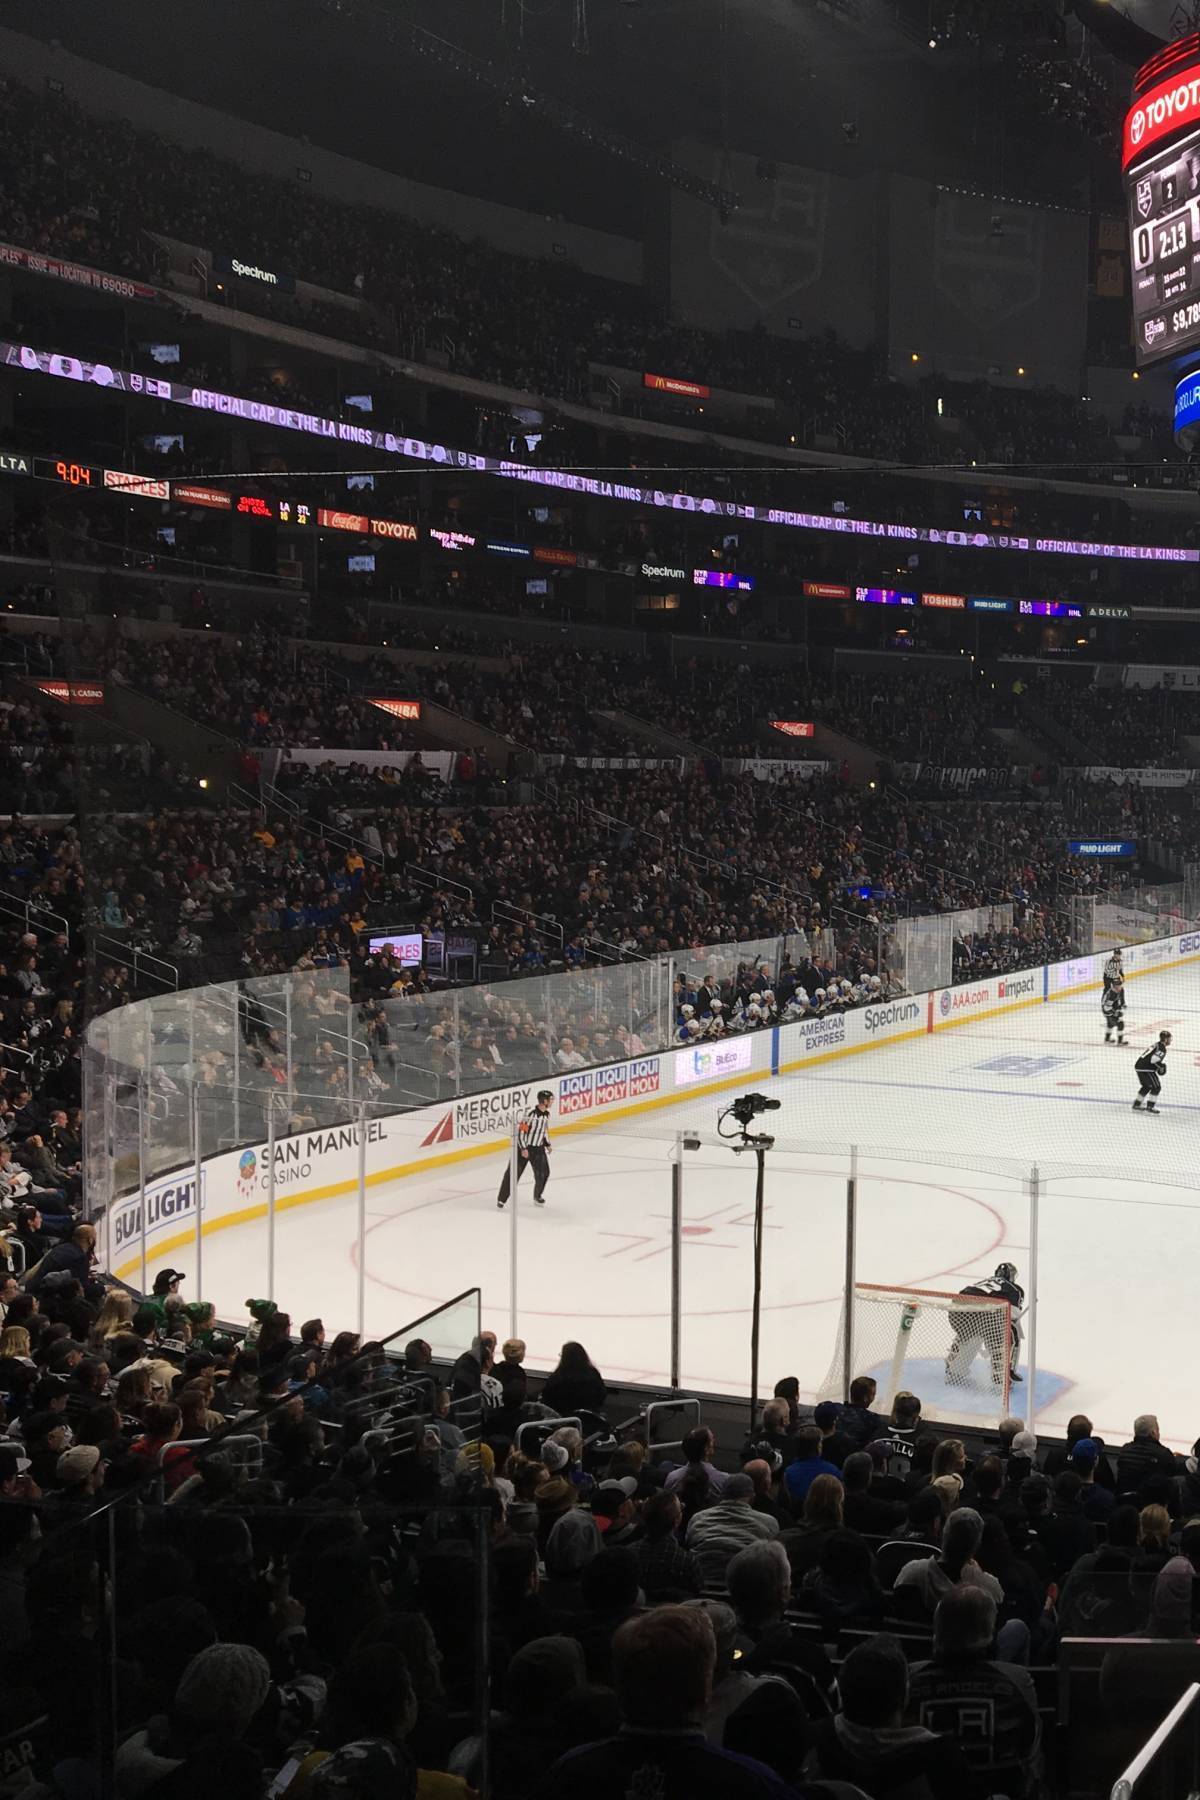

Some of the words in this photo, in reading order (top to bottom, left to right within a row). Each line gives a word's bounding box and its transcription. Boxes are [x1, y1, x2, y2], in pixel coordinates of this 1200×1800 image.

[1167, 182, 1174, 198] 2
[1139, 225, 1150, 265] 0
[1159, 221, 1187, 259] 2:13
[60, 265, 92, 287] LOCATION
[103, 278, 136, 297] 69050
[231, 259, 277, 285] Spectrum
[191, 388, 247, 420] OFFICIAL
[249, 401, 275, 424] CAP
[279, 408, 294, 428] OF
[296, 411, 318, 433] THE
[320, 419, 338, 438] LA
[339, 422, 373, 446] KINGS
[57, 461, 91, 486] 9:04
[106, 472, 168, 499] STAPLES
[545, 471, 564, 487] CAP
[566, 474, 580, 489] OF
[580, 477, 599, 494] THE
[600, 481, 612, 496] LA
[613, 483, 641, 502] KINGS
[279, 501, 290, 512] LA
[297, 504, 311, 517] STL
[371, 519, 418, 541] TOYOTA
[768, 509, 808, 527] OFFICIAL
[811, 514, 832, 530] CAP
[835, 518, 848, 531] OF
[850, 519, 870, 534] THE
[873, 522, 885, 536] LA
[887, 523, 918, 540] KINGS
[1036, 539, 1078, 553] OFFICIAL
[1081, 541, 1101, 555] CAP
[1103, 543, 1116, 556] OF
[1118, 544, 1137, 557] THE
[1139, 546, 1152, 559] LA
[1155, 547, 1187, 561] KINGS
[640, 563, 686, 580] Spectrum
[922, 595, 965, 609] TOSHIBA
[1098, 607, 1129, 617] DELTA
[1079, 844, 1099, 853] BUD
[1099, 843, 1122, 853] LIGHT
[952, 988, 990, 1009] AAA.com
[1004, 976, 1034, 1000] impact
[799, 1016, 845, 1038] AMERICAN
[864, 1002, 917, 1034] Spectrum
[805, 1031, 845, 1051] EXPRESS
[596, 1067, 626, 1089] LIQUI
[630, 1059, 659, 1080] LIQUI
[561, 1074, 592, 1096] LIQUI
[596, 1083, 627, 1105] MOLY
[630, 1075, 660, 1096] MOLY
[456, 1088, 532, 1122] MERCURY
[561, 1091, 592, 1114] MOLY
[456, 1106, 532, 1138] INSURANCE
[261, 1139, 299, 1170] SAN
[307, 1121, 388, 1158] MANUEL
[261, 1163, 312, 1190] CASINO
[147, 1181, 199, 1225] LIGHT
